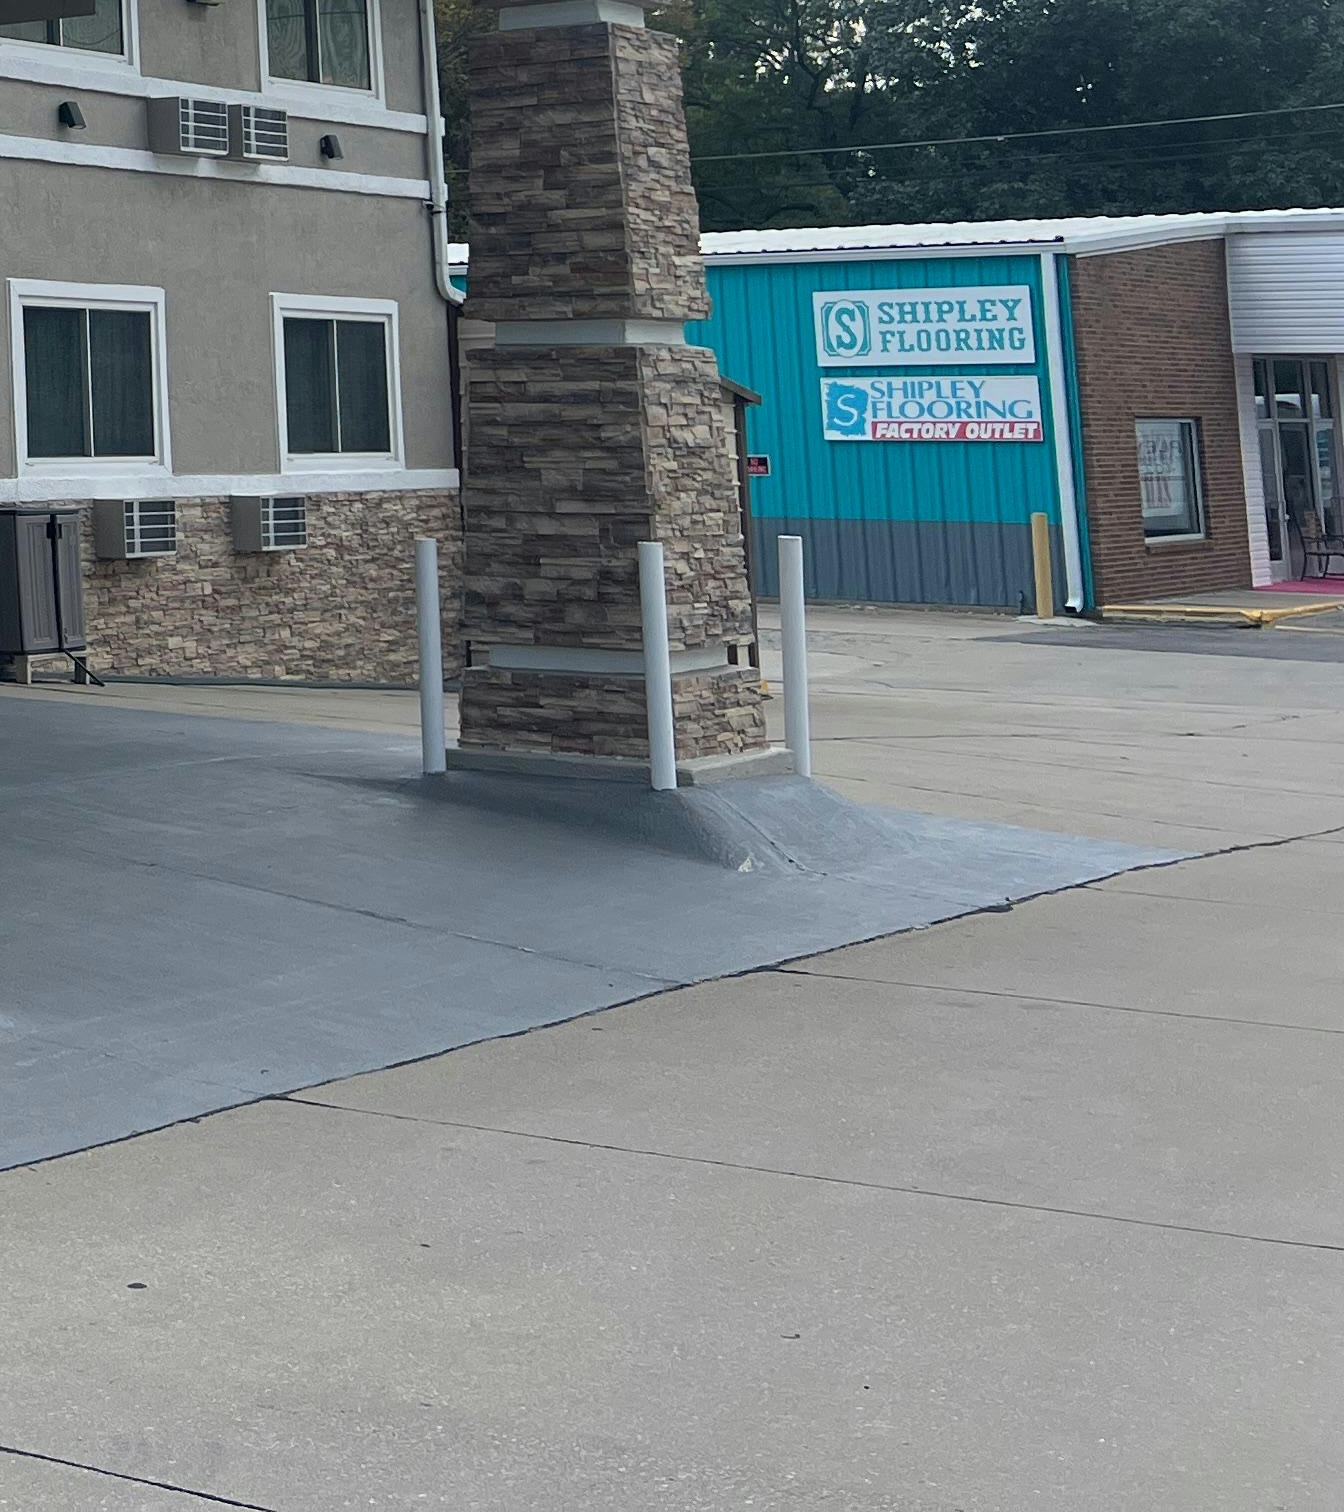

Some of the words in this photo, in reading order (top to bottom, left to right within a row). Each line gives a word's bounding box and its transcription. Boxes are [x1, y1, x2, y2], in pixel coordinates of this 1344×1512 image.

[877, 298, 1023, 325] SHIPLEY
[835, 307, 858, 351] S
[880, 327, 1026, 353] FLOORING
[870, 380, 986, 399] SHIPLEY
[835, 394, 858, 426] S
[871, 399, 1033, 419] FLOORING
[875, 422, 962, 439] FACTORY
[965, 422, 1039, 439] OUTLET
